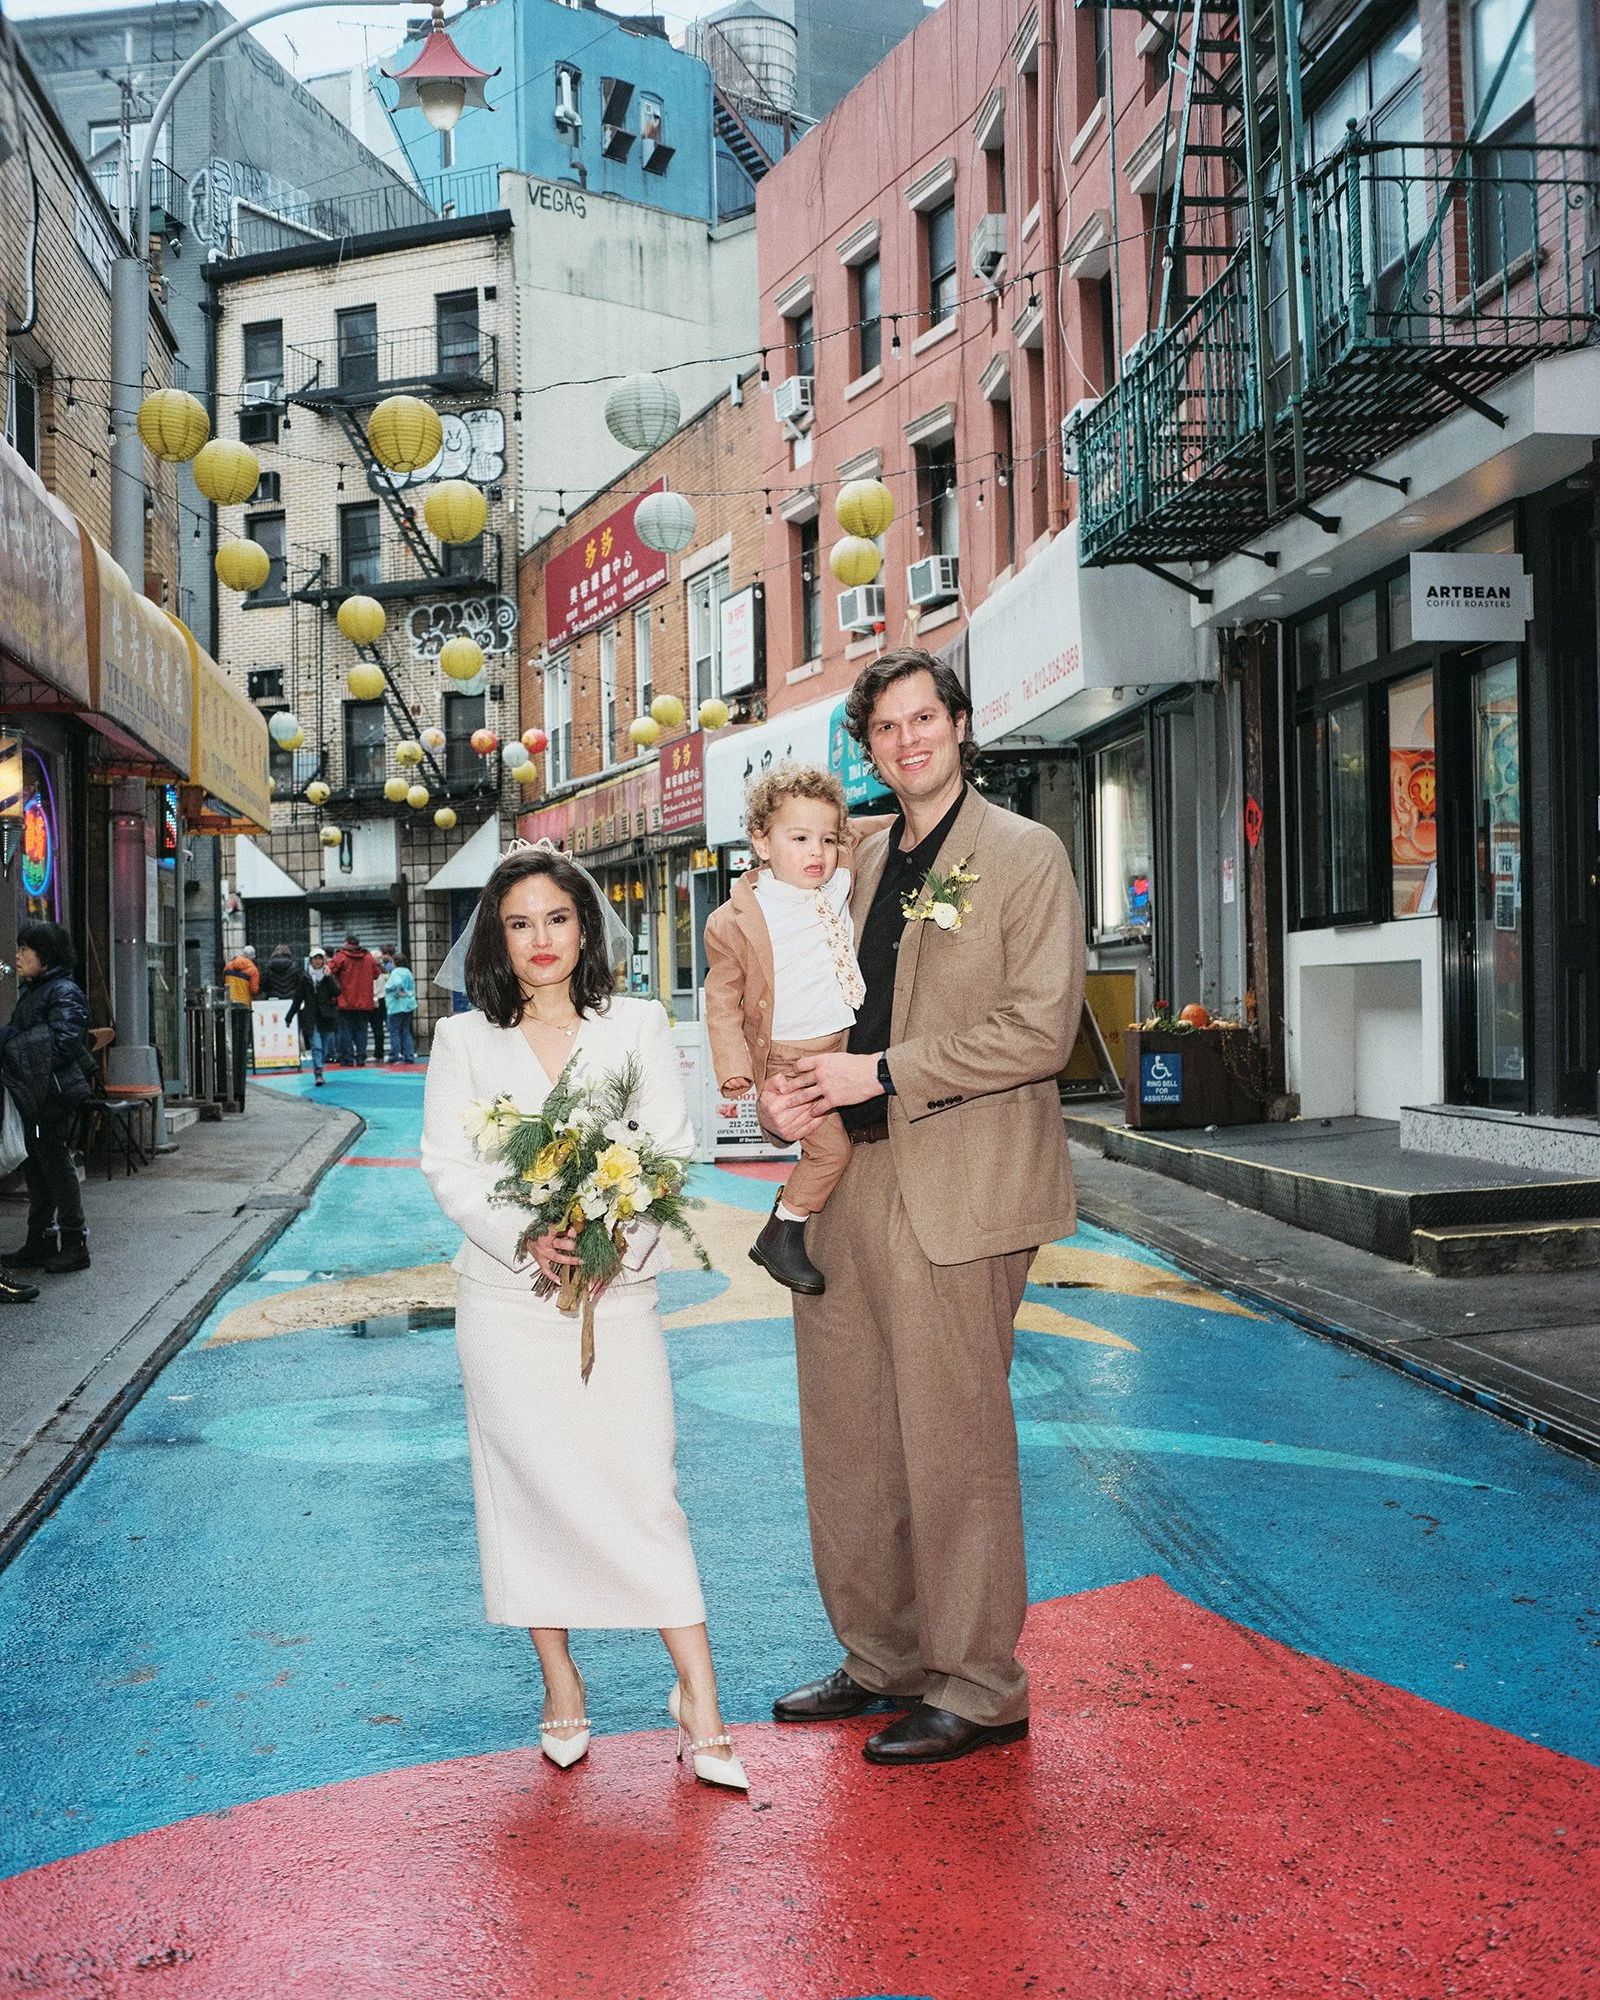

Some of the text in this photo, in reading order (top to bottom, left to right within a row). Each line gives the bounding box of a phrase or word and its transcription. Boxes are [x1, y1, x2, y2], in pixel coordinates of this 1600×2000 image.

[527, 183, 586, 219] VEGAS
[1426, 586, 1510, 599] ARTBEAN
[1426, 600, 1511, 608] COFFEE ROASTERS
[1143, 1094, 1180, 1102] ASSISTANCE
